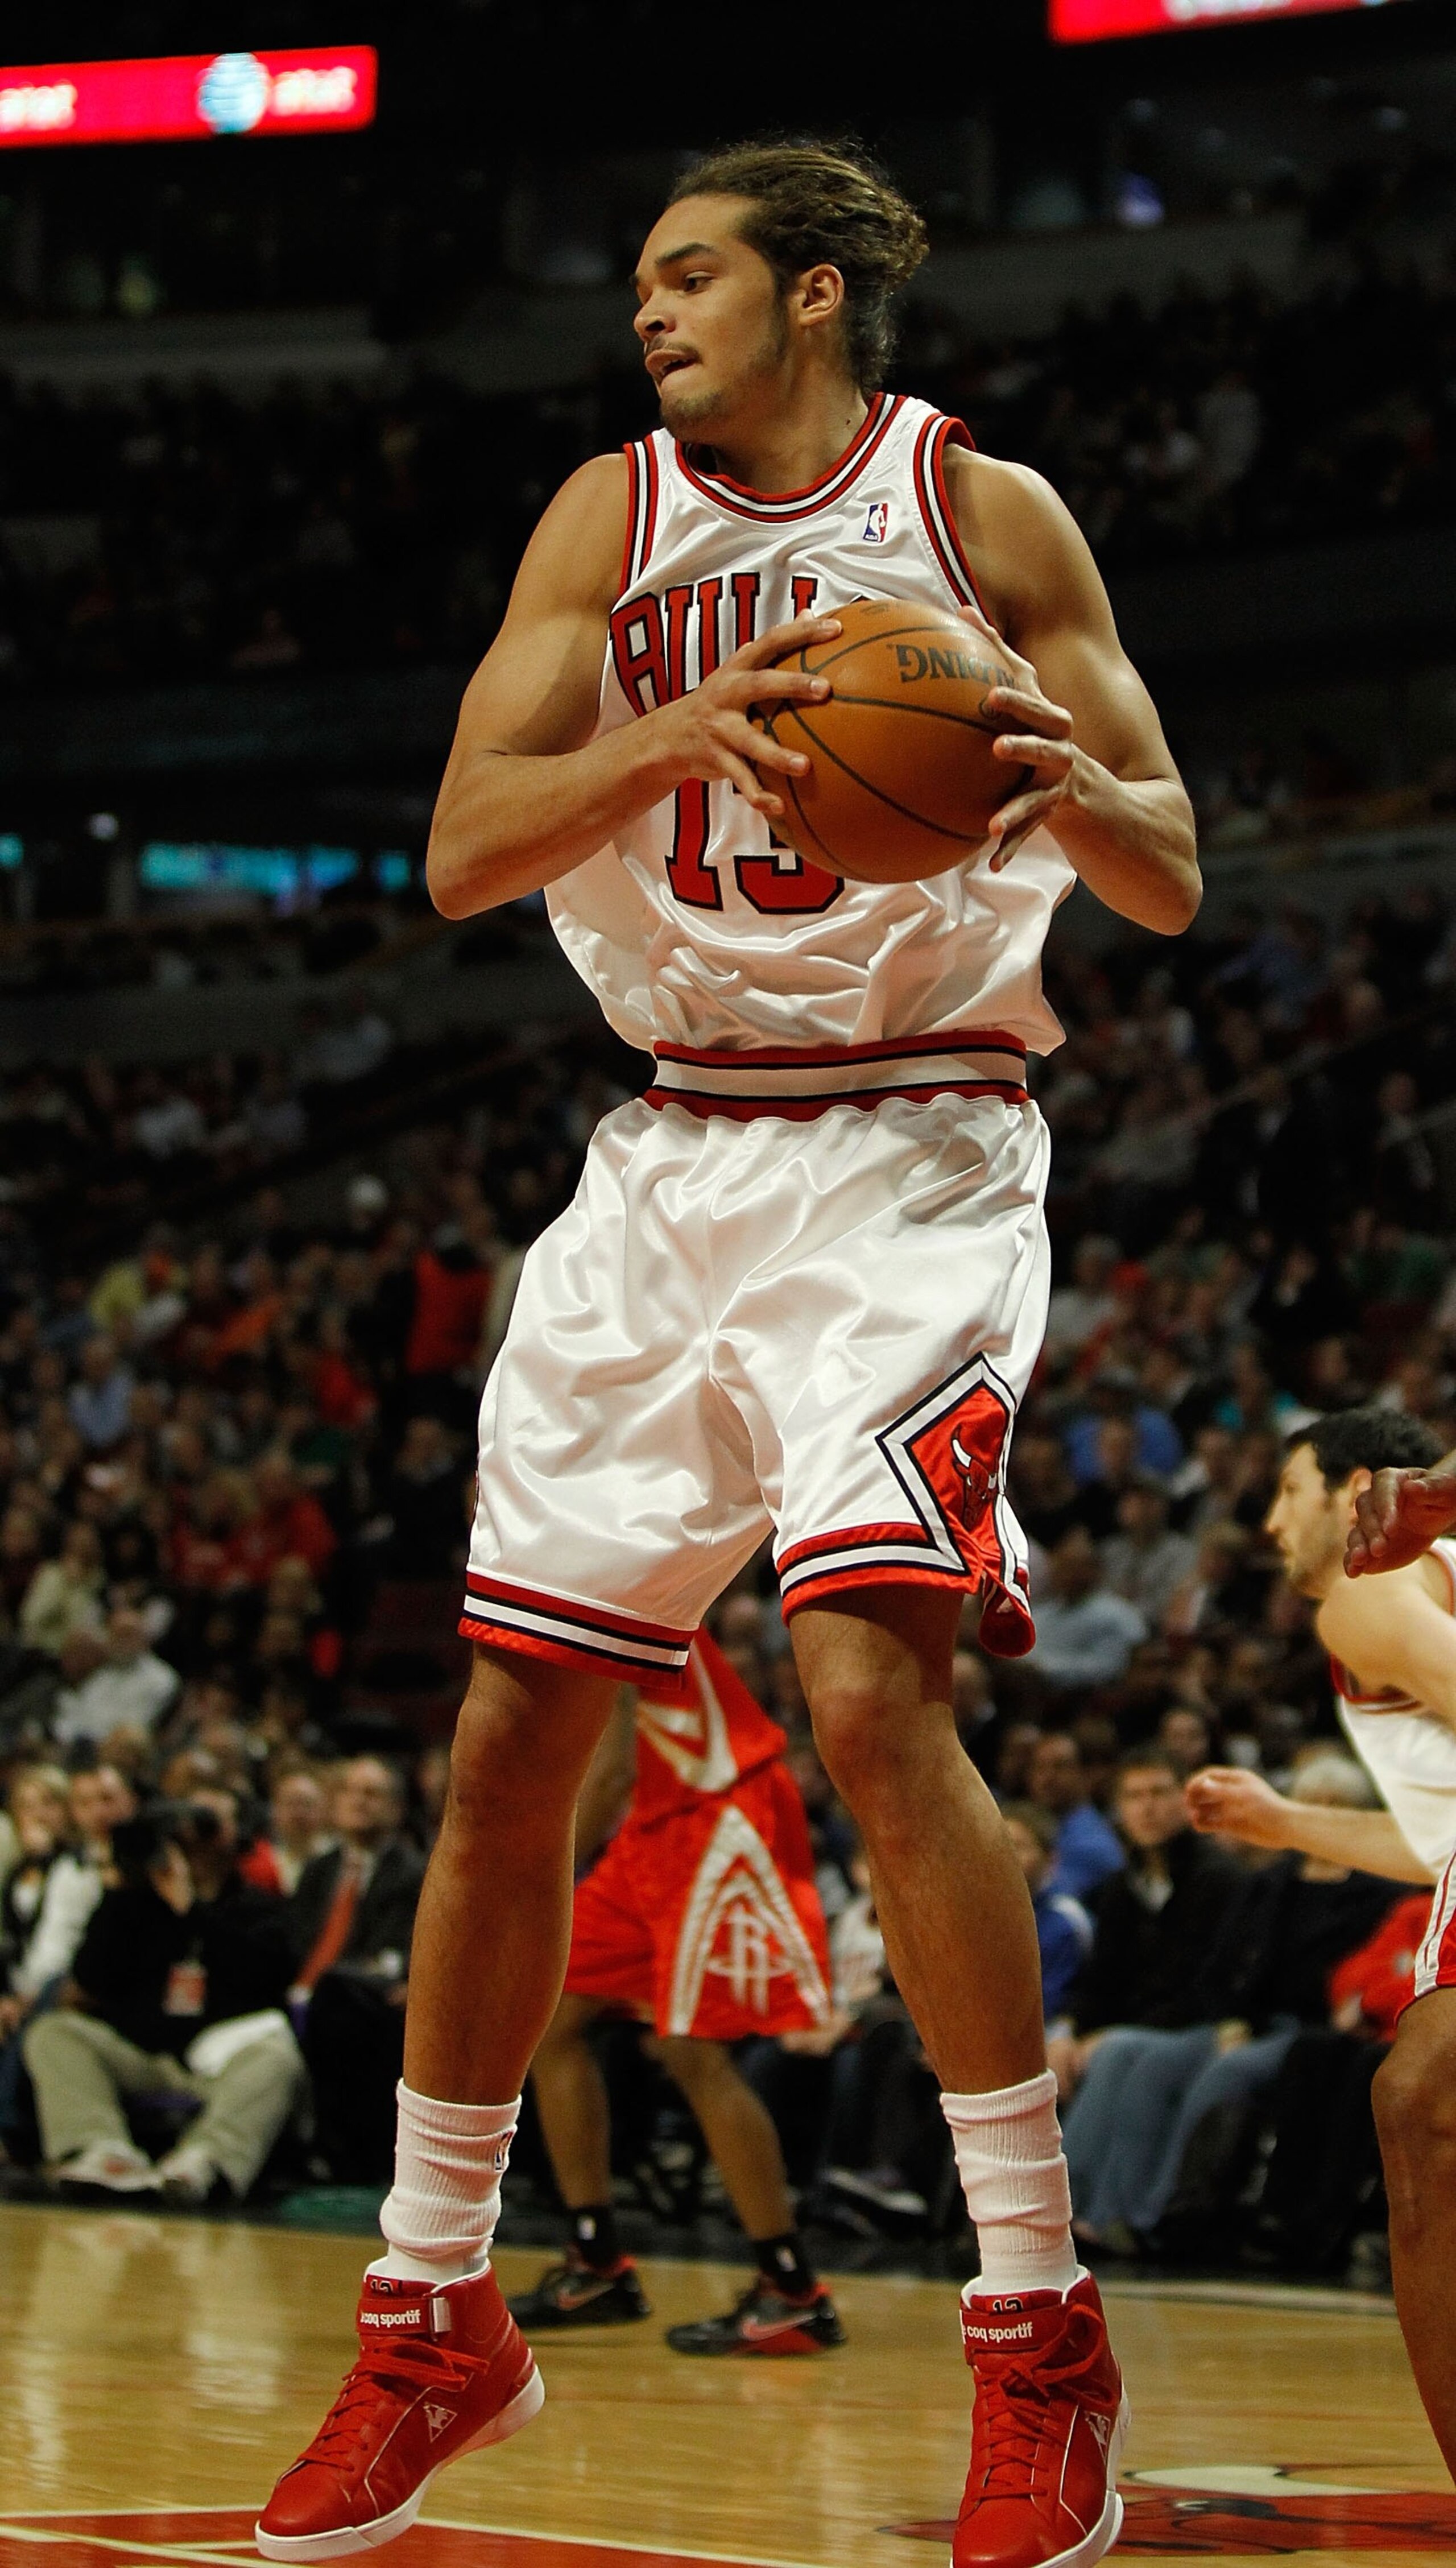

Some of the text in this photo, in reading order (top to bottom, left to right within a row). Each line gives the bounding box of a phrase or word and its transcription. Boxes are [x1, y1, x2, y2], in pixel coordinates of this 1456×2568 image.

[380, 2309, 421, 2328] sportif
[967, 2325, 988, 2343] coq
[988, 2321, 1033, 2343] sportif
